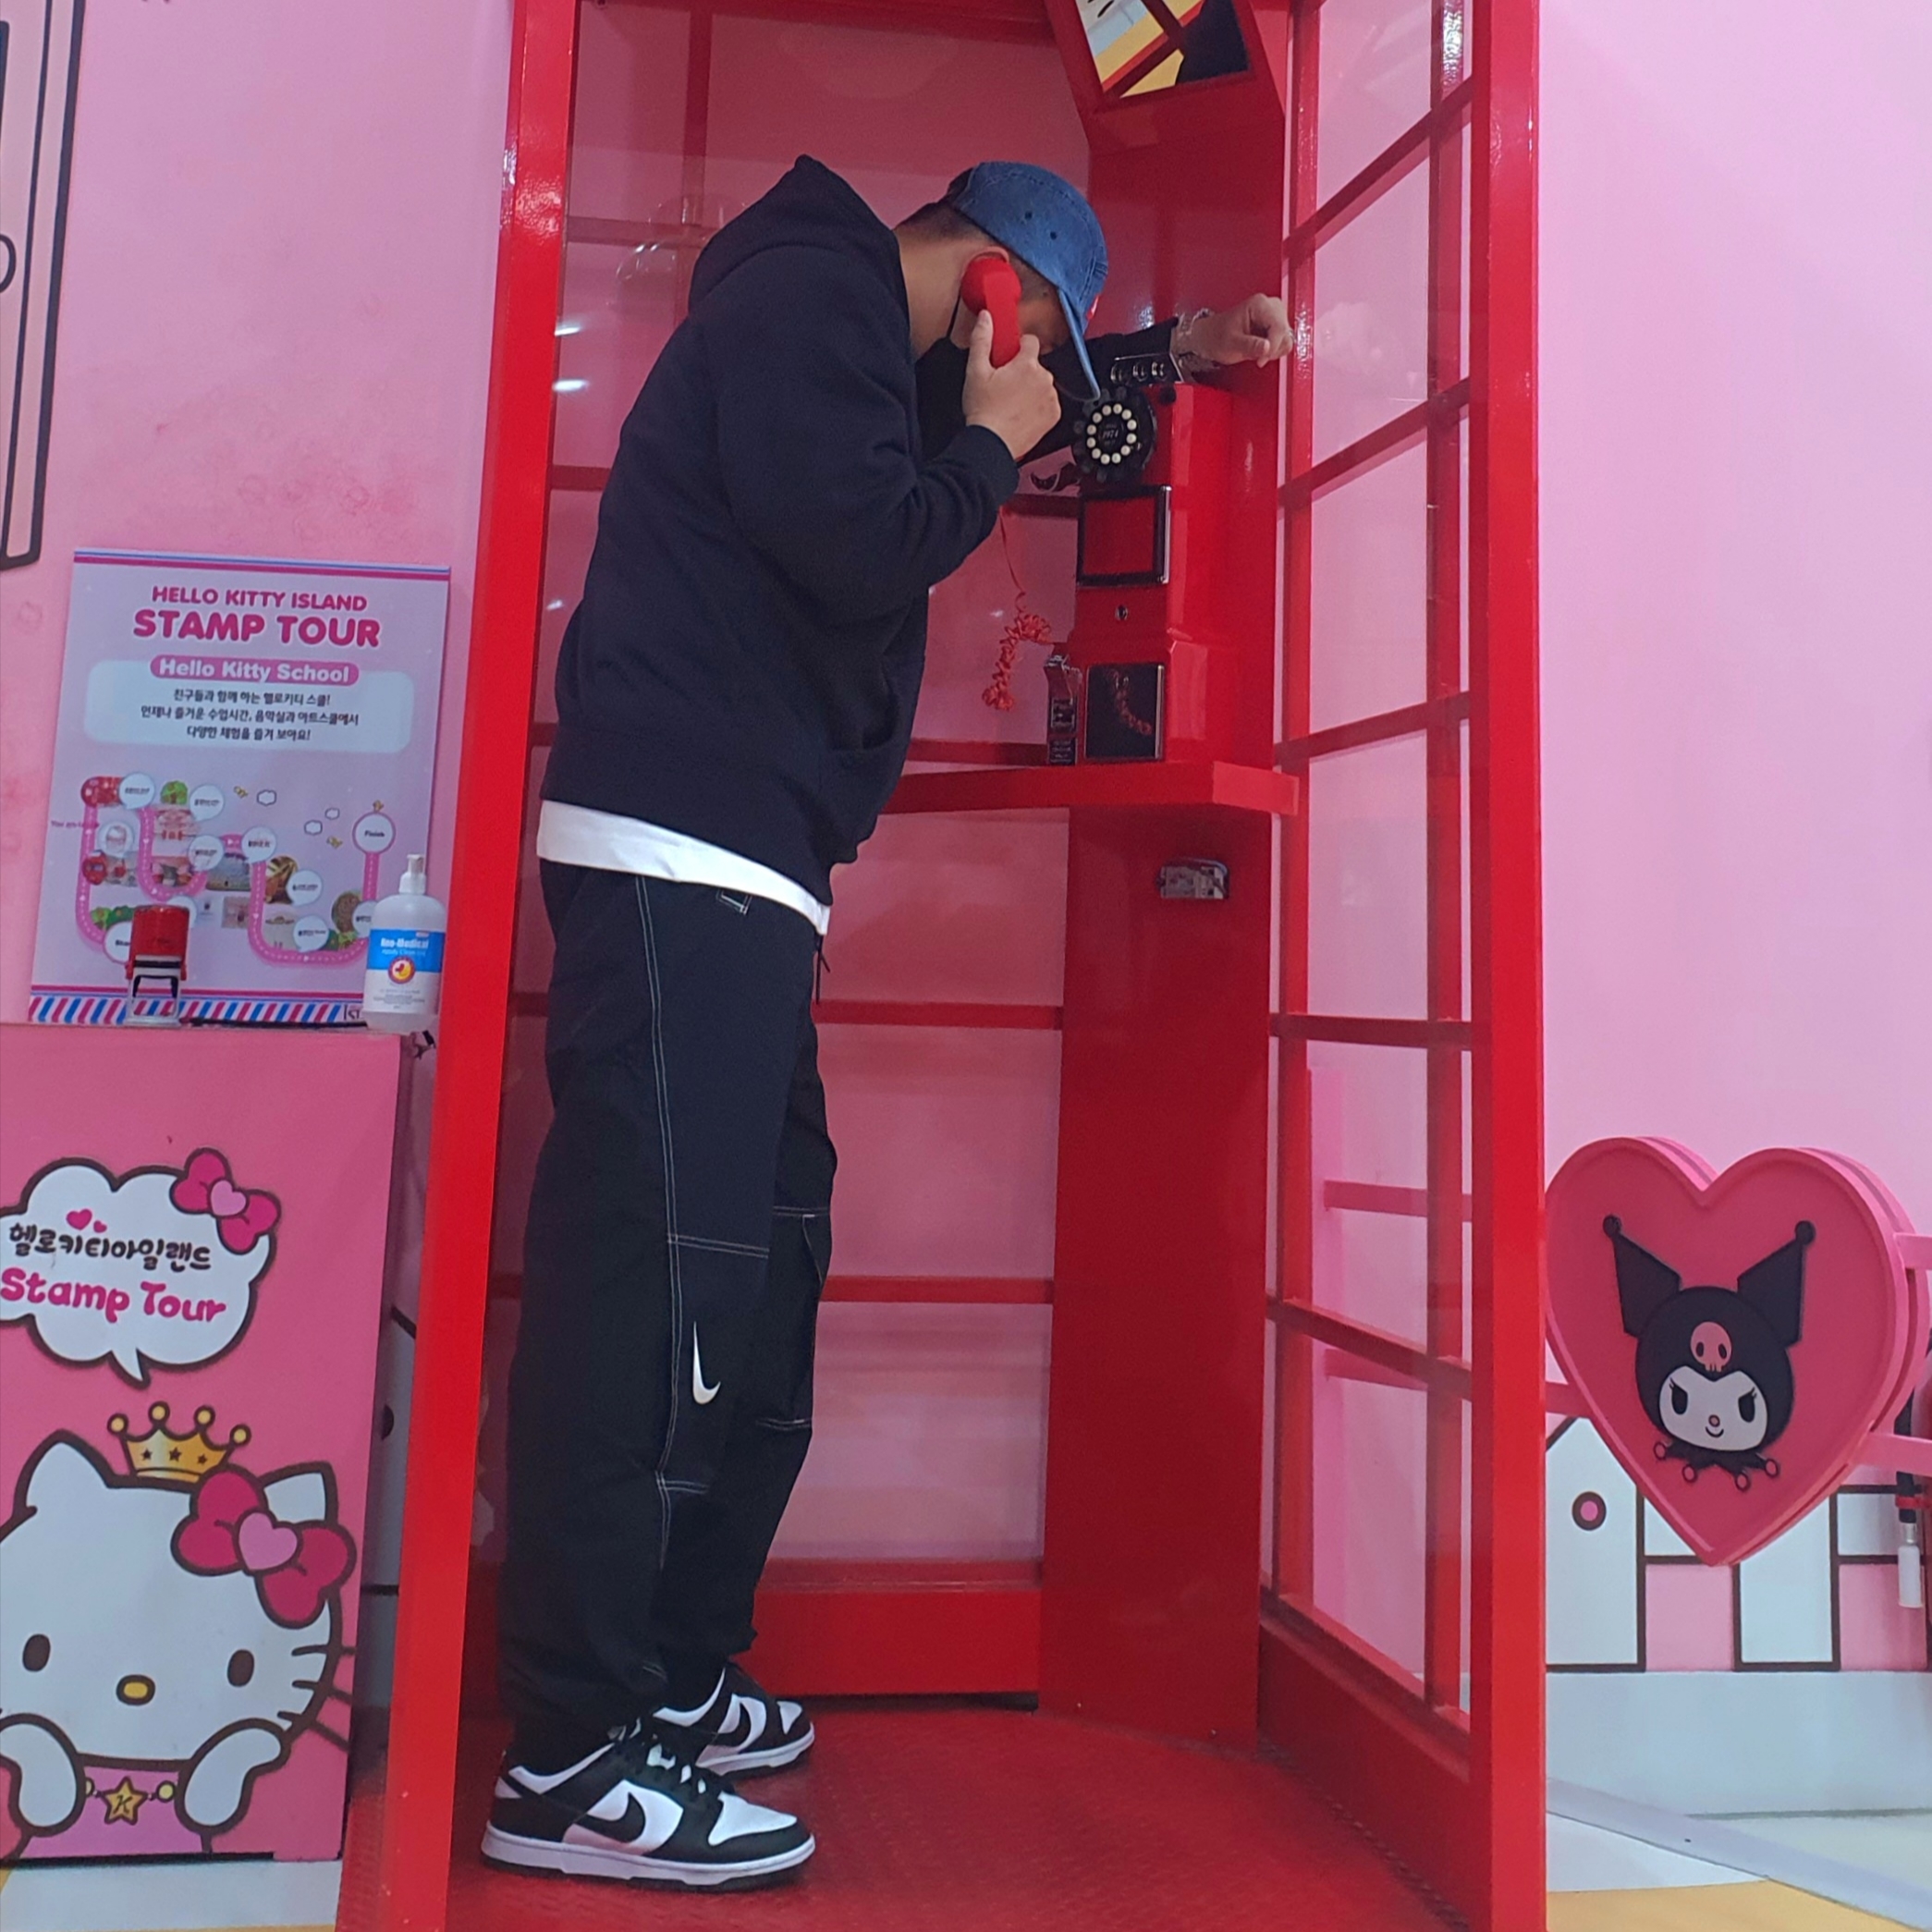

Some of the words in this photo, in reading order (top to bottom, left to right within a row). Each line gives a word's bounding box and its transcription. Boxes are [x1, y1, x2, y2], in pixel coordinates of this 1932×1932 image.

[152, 585, 219, 605] HELLO
[225, 589, 287, 608] KITTY
[291, 592, 368, 612] ISLAND
[133, 608, 265, 642] STAMP
[276, 615, 381, 648] TOUR
[159, 657, 214, 678] Hello
[222, 660, 271, 683] Kitty
[277, 663, 349, 683] School
[174, 688, 214, 703] 친구들과
[217, 690, 238, 704] 함께
[263, 691, 304, 706] 헬로키티
[141, 704, 172, 719] 언제나
[175, 706, 205, 720] 즐거운
[208, 708, 252, 722] 수업시간,
[255, 709, 296, 724] 음악실과
[297, 711, 360, 727] 아트스쿨에서
[187, 725, 218, 740] 다양한
[8, 1221, 213, 1273] 헬로키티아일랜드
[0, 1266, 131, 1324] Stamp
[140, 1279, 227, 1323] Tour
